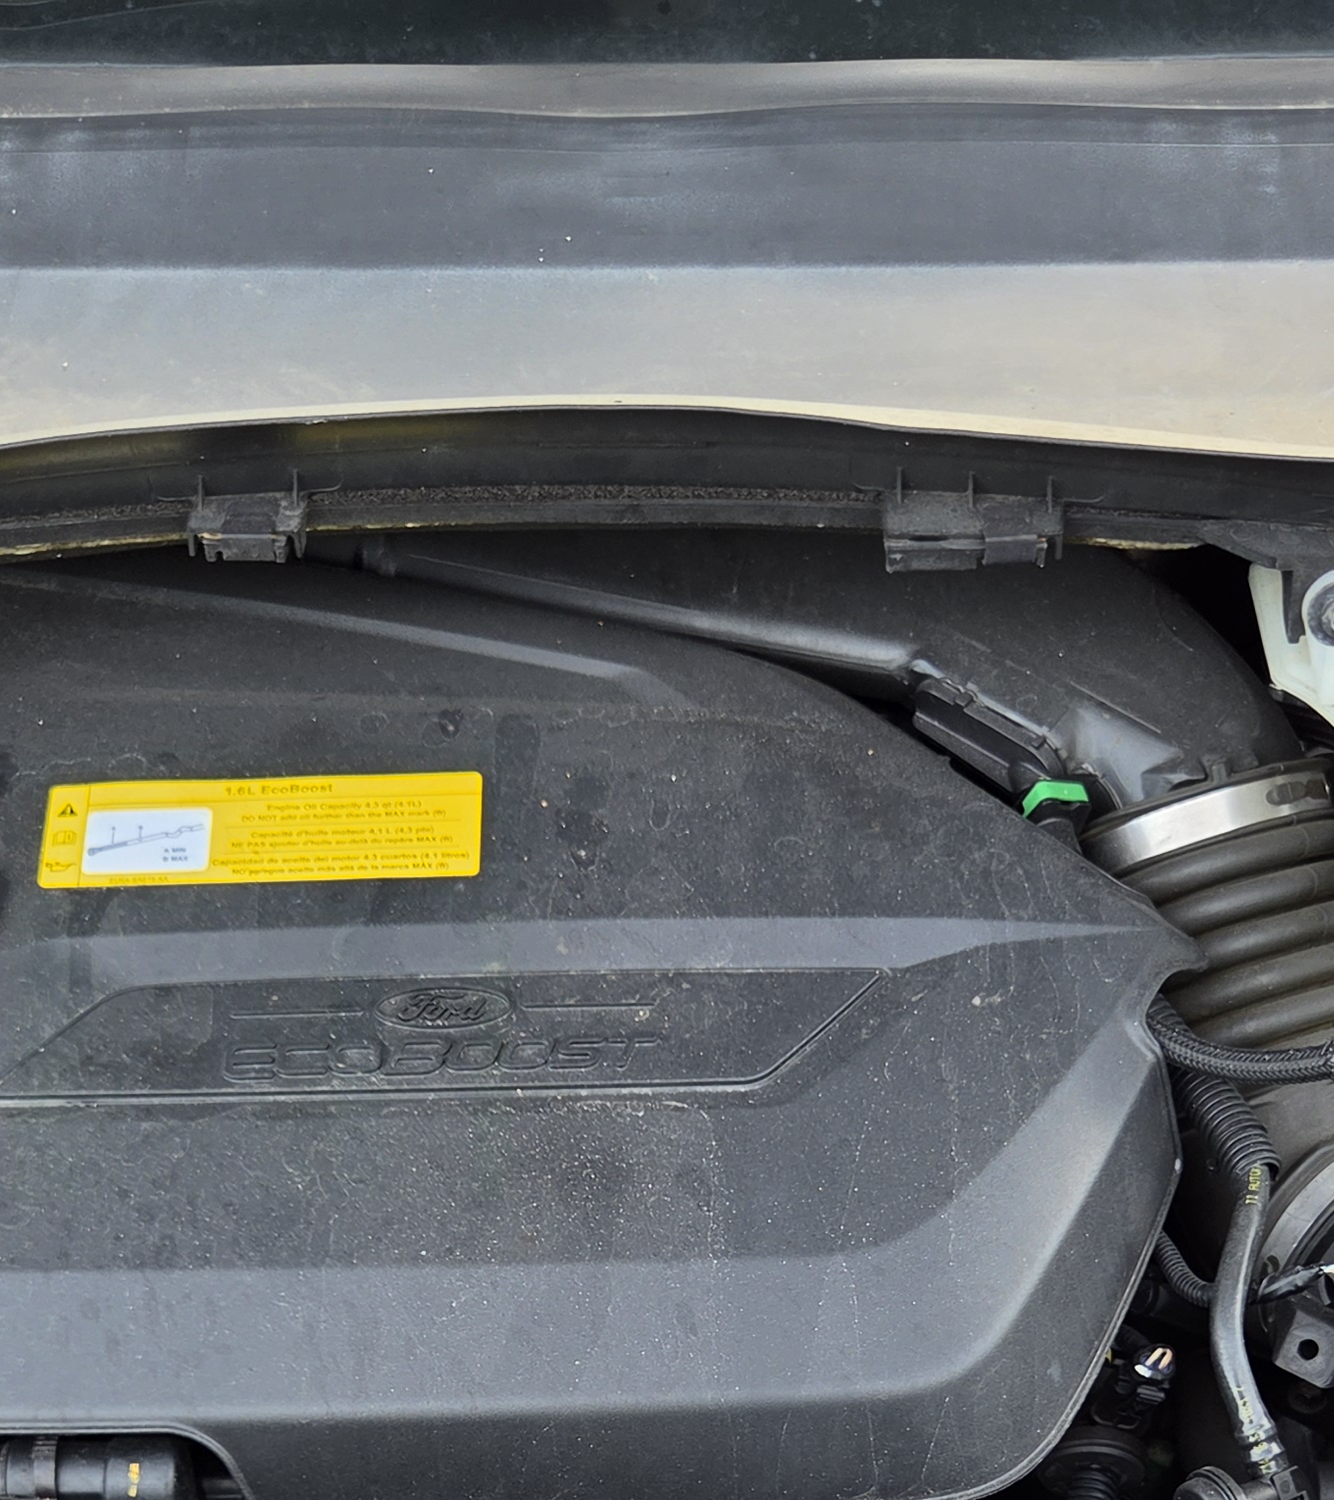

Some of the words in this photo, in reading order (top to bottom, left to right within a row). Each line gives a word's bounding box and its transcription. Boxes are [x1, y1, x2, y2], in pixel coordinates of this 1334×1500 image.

[261, 784, 333, 795] EcoBoost
[396, 992, 487, 1023] Ford
[224, 1036, 663, 1081] ECOBOOST
